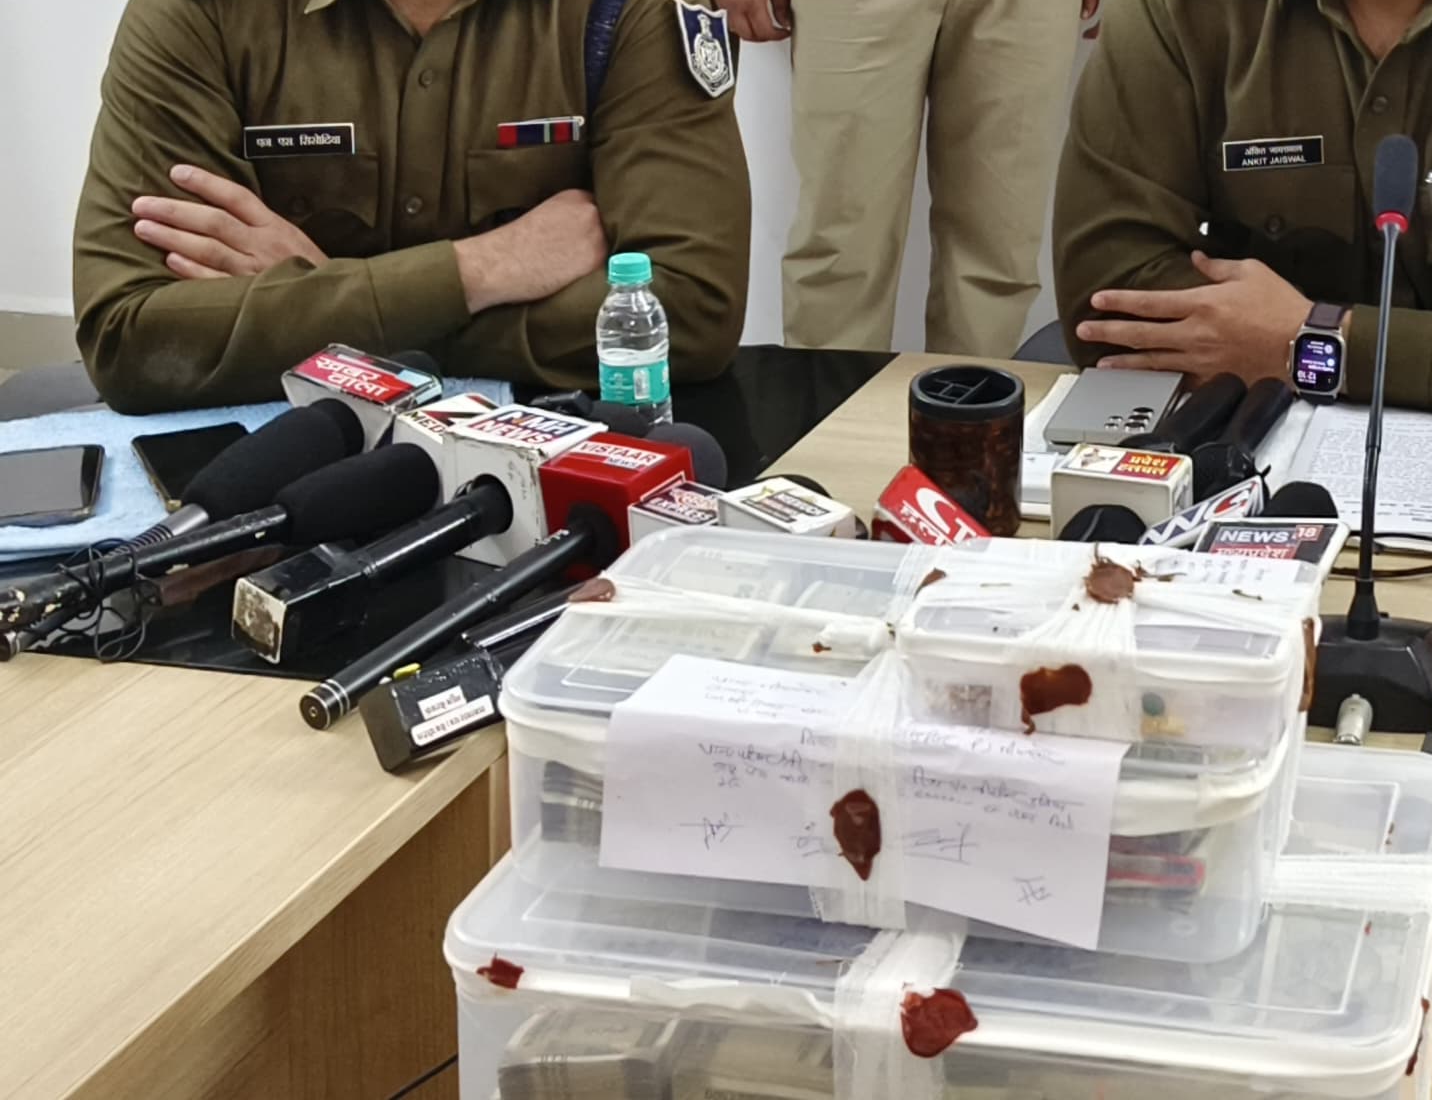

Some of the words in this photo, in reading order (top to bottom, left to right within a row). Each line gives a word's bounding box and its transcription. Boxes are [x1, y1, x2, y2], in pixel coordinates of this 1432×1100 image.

[1241, 157, 1268, 167] ANKIT
[1269, 154, 1307, 166] JAISWAL
[315, 356, 383, 383] खबर
[327, 372, 390, 398] वाला
[404, 411, 444, 436] MED
[477, 419, 557, 446] NEWS
[578, 441, 660, 465] VISTAAR
[1219, 529, 1290, 543] NEWS
[1297, 526, 1317, 538] 18
